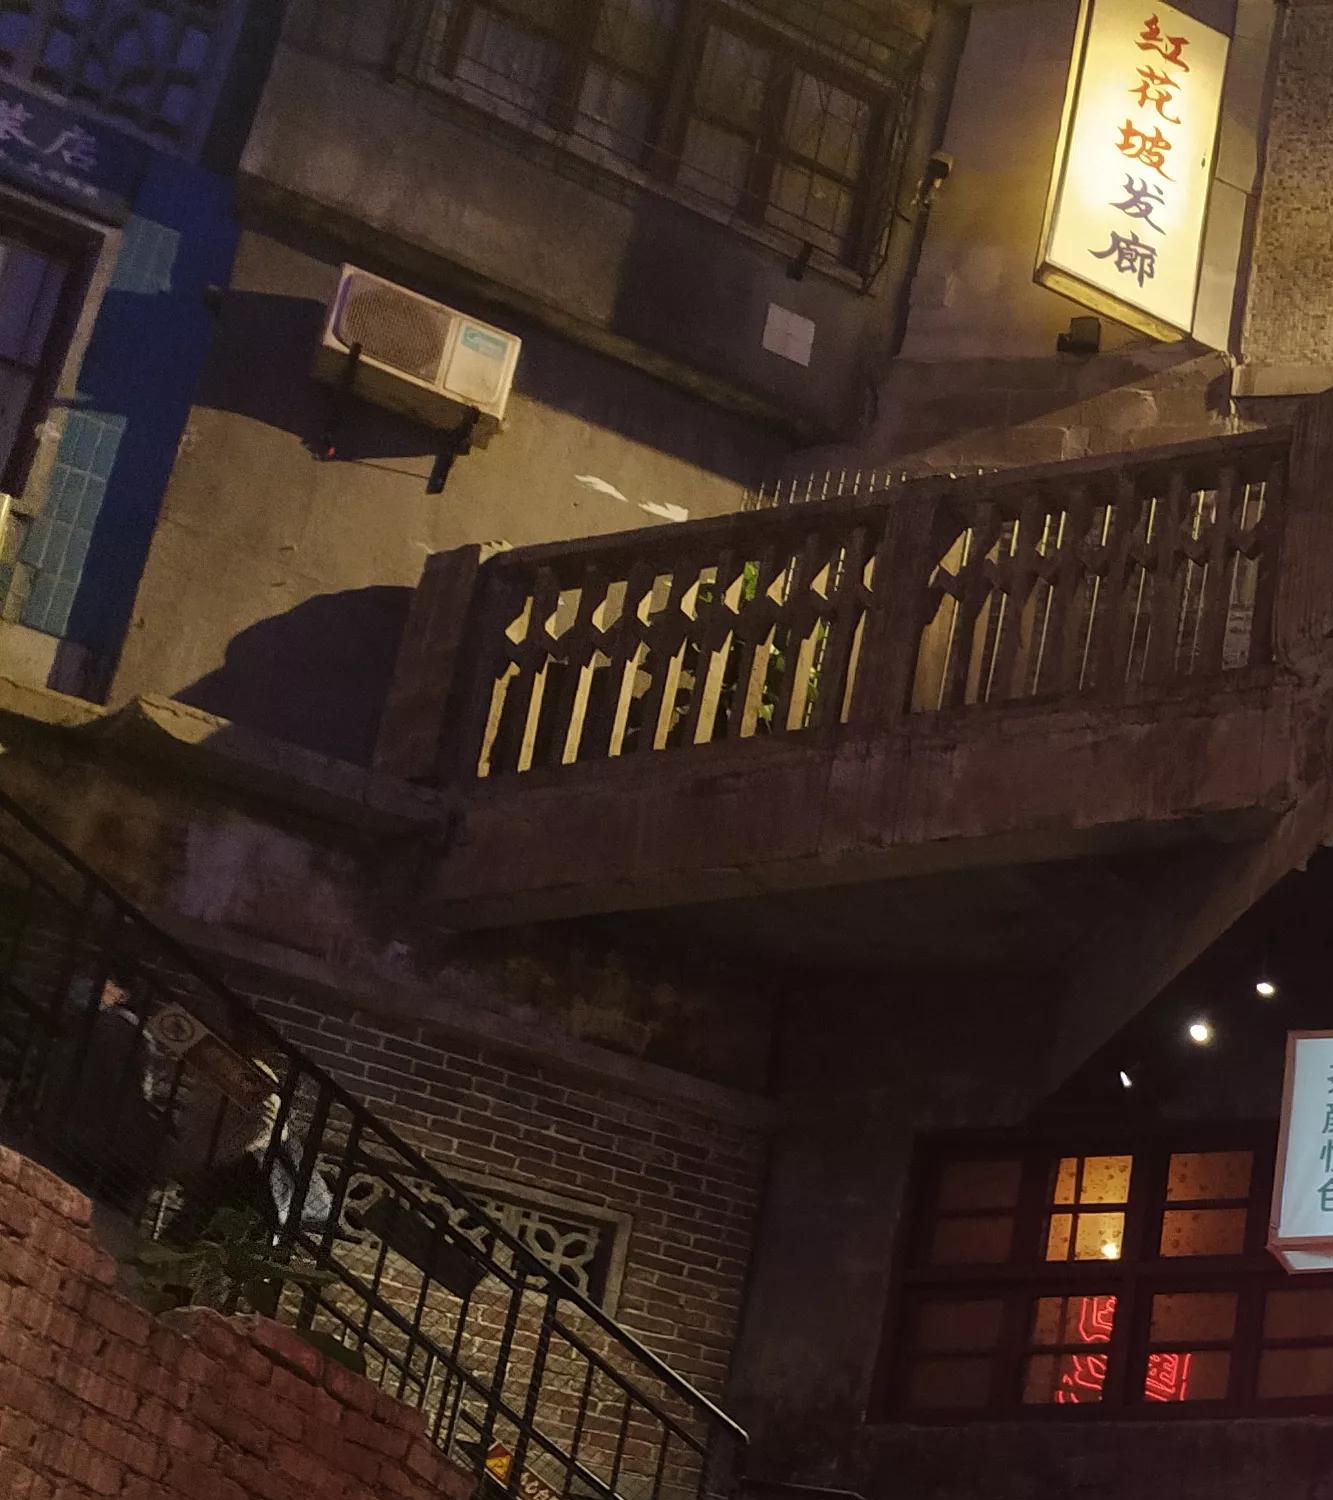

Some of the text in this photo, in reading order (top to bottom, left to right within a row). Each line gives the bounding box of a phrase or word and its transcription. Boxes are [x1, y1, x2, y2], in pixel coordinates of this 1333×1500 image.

[1088, 13, 1190, 288] 红花坡发廊
